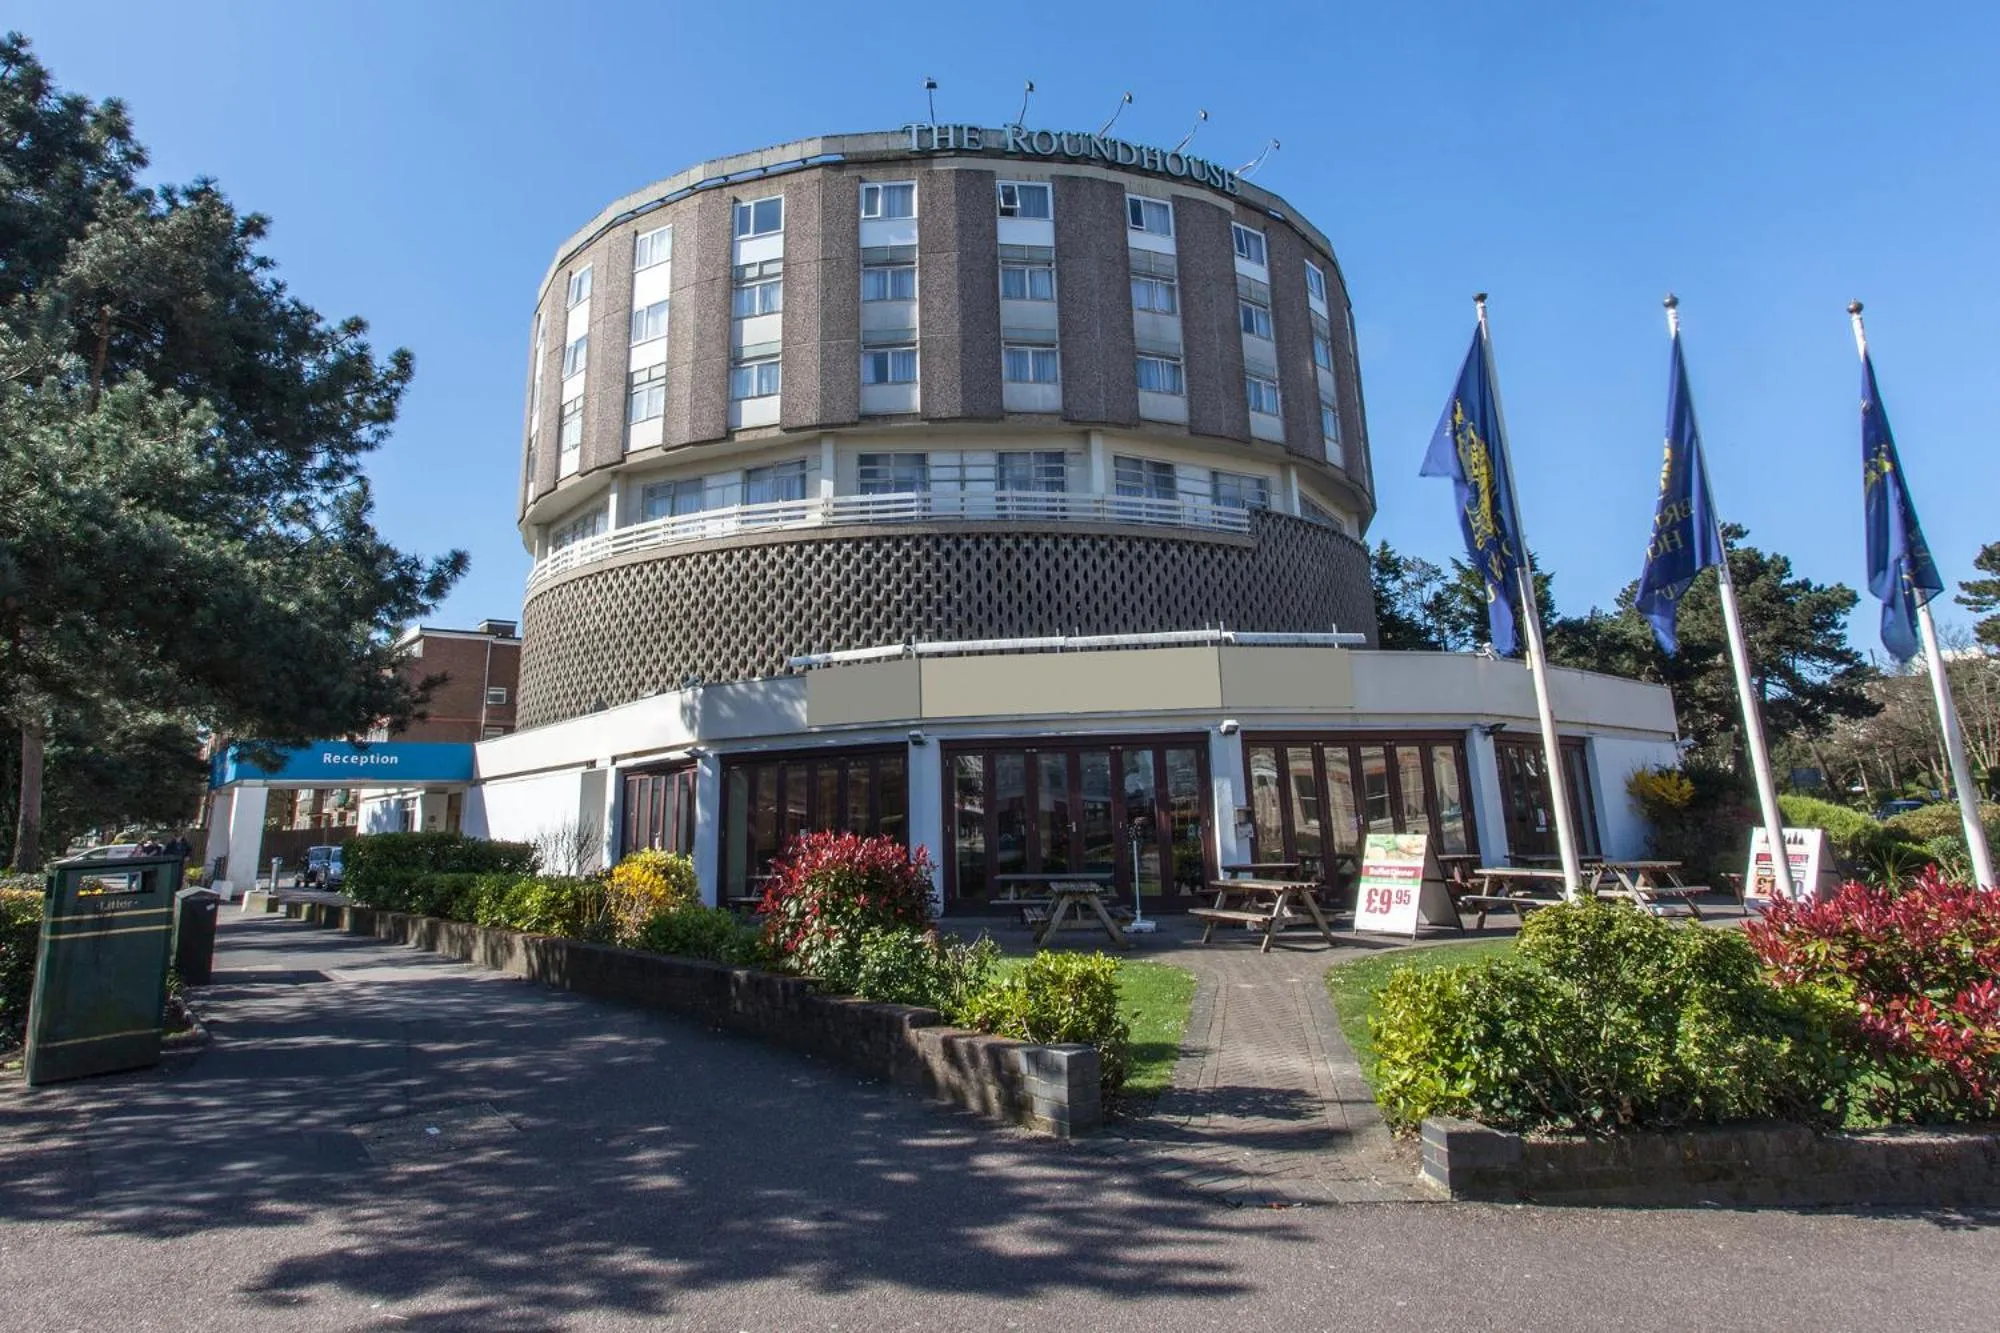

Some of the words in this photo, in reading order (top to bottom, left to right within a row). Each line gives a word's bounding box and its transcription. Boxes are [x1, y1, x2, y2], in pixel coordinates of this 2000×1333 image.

[904, 123, 983, 153] THE
[1003, 123, 1239, 195] ROUNDHOUSE
[323, 752, 399, 766] Reception
